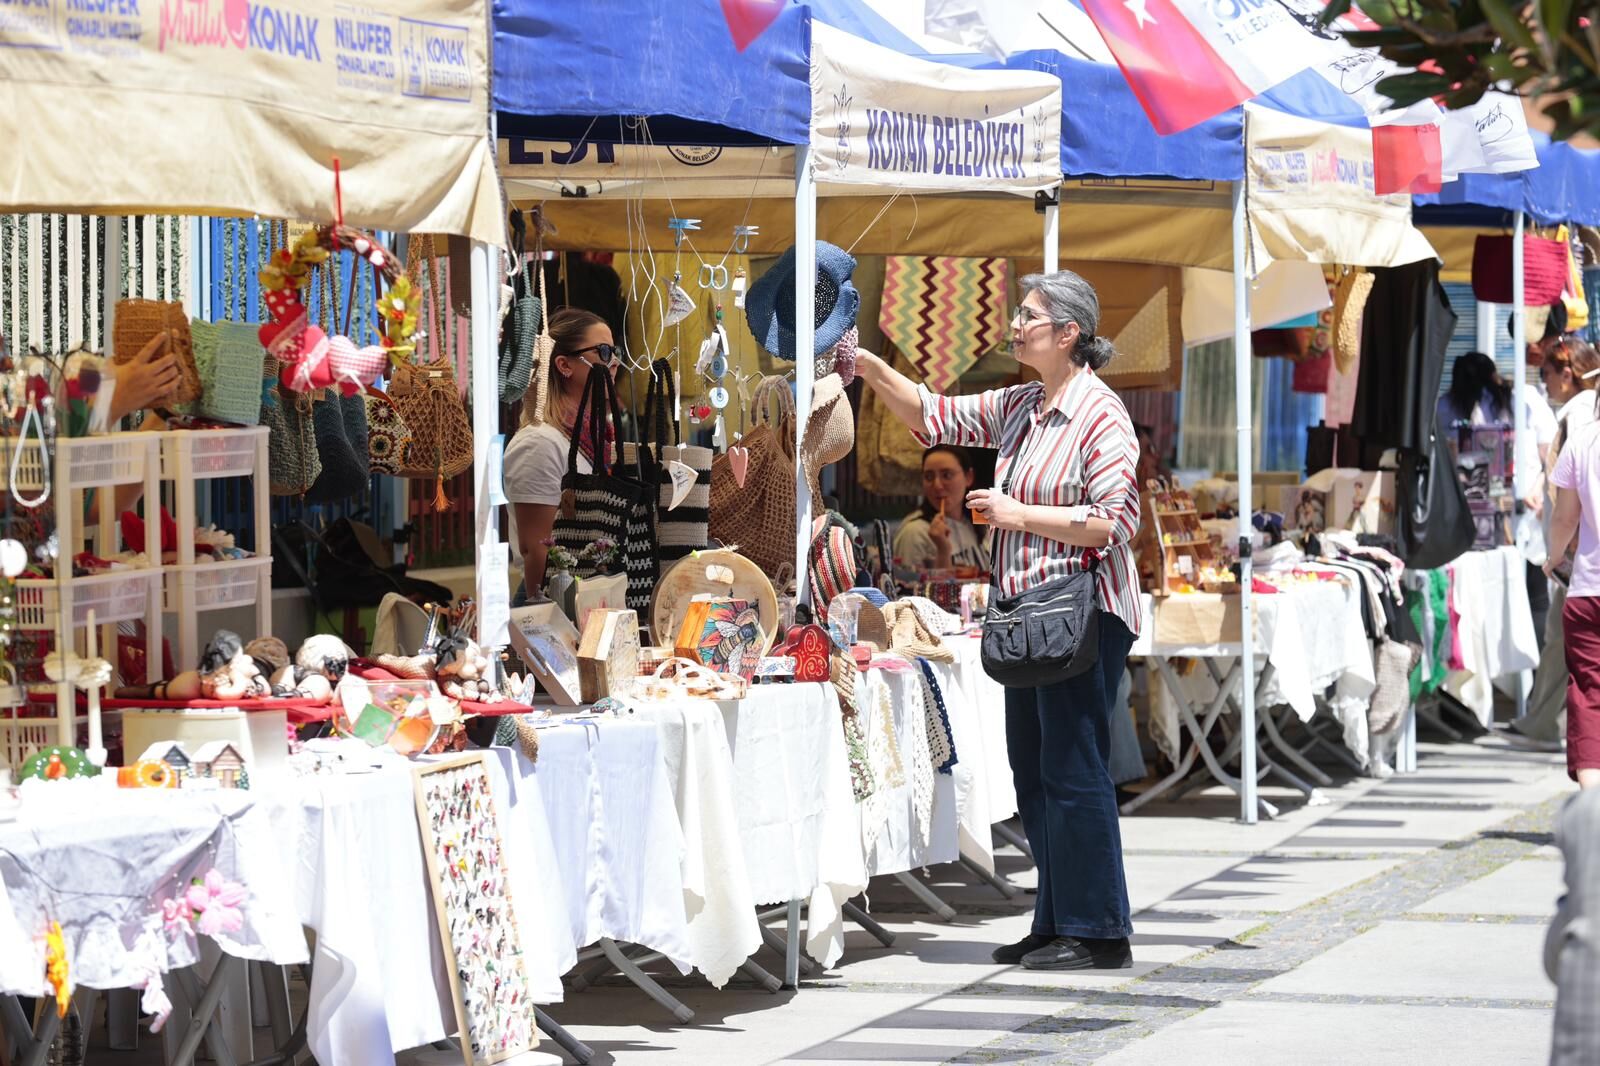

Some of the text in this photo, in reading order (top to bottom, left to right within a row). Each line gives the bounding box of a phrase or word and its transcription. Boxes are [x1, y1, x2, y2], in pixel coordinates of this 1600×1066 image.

[246, 3, 321, 63] KONAK
[426, 35, 466, 66] KONAK
[675, 148, 692, 161] KONAK
[865, 104, 1026, 178] KONAK BELEDİYESİ
